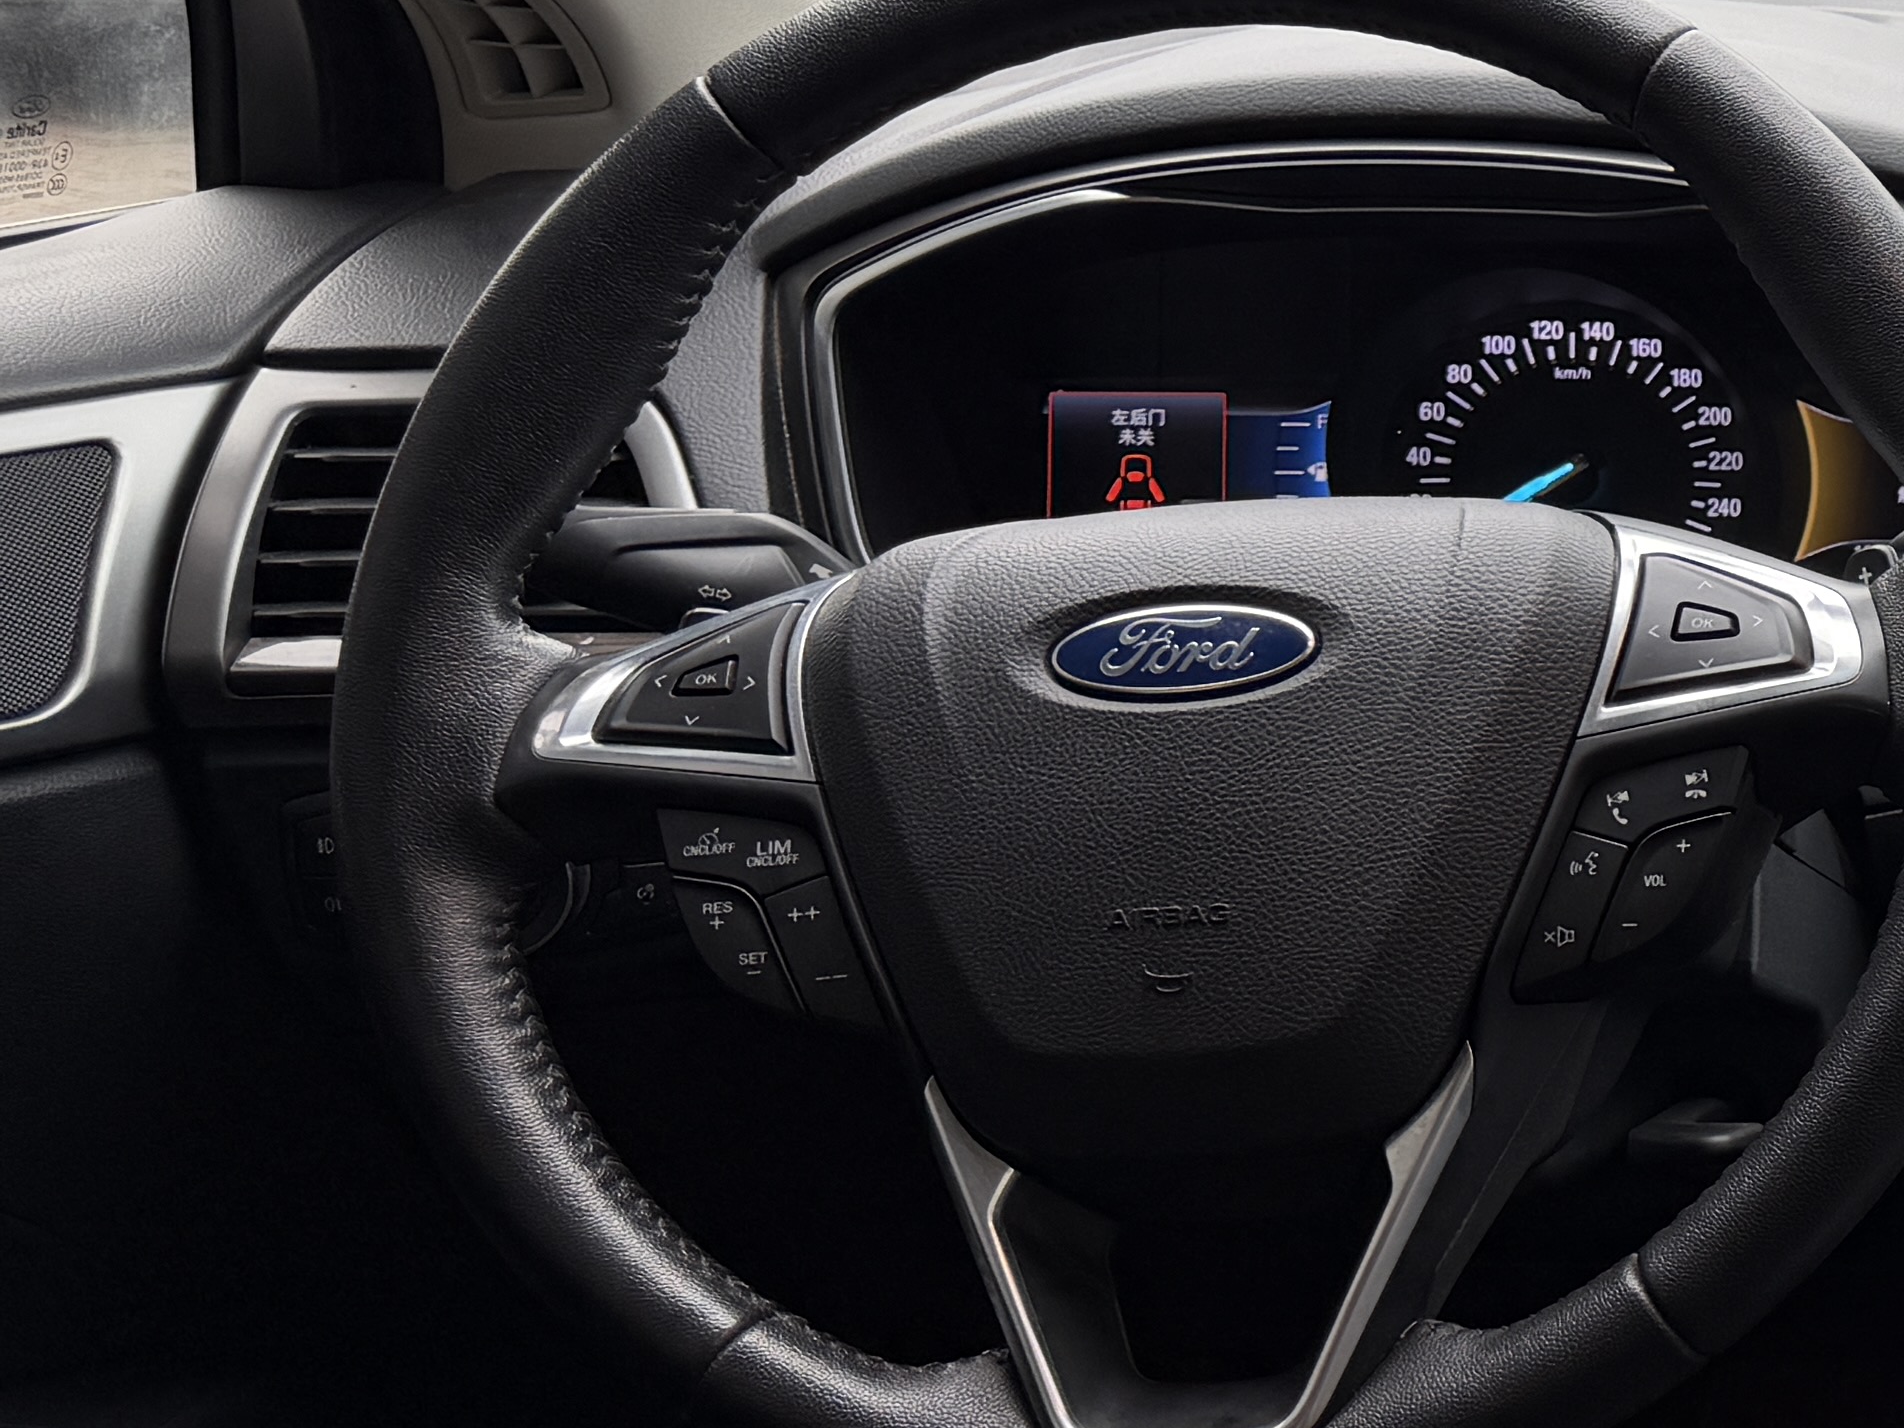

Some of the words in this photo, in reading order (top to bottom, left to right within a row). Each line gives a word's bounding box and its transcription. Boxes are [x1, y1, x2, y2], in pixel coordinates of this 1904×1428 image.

[1530, 320, 1564, 341] 120
[1581, 321, 1615, 342] 140
[1481, 335, 1516, 356] 100
[1628, 338, 1662, 358] 160
[1446, 364, 1473, 384] 80
[1553, 367, 1592, 382] km/h
[1669, 368, 1703, 388] 180
[1110, 408, 1166, 427] 左后门
[1418, 401, 1446, 421] 60
[1697, 406, 1732, 426] 200
[1118, 429, 1156, 447] 未关
[1405, 446, 1431, 467] 40
[1708, 450, 1744, 471] 220
[1707, 497, 1742, 517] 240
[1690, 615, 1716, 630] OK
[1100, 616, 1261, 679] Ford
[695, 673, 718, 687] OK
[683, 841, 736, 858] CNCL/OFF
[755, 839, 792, 856] LIM
[746, 852, 799, 869] CNCL/OFF
[1642, 872, 1668, 888] VOL
[702, 900, 734, 916] RES
[1109, 902, 1231, 932] AIRBAG
[738, 951, 768, 966] SET
